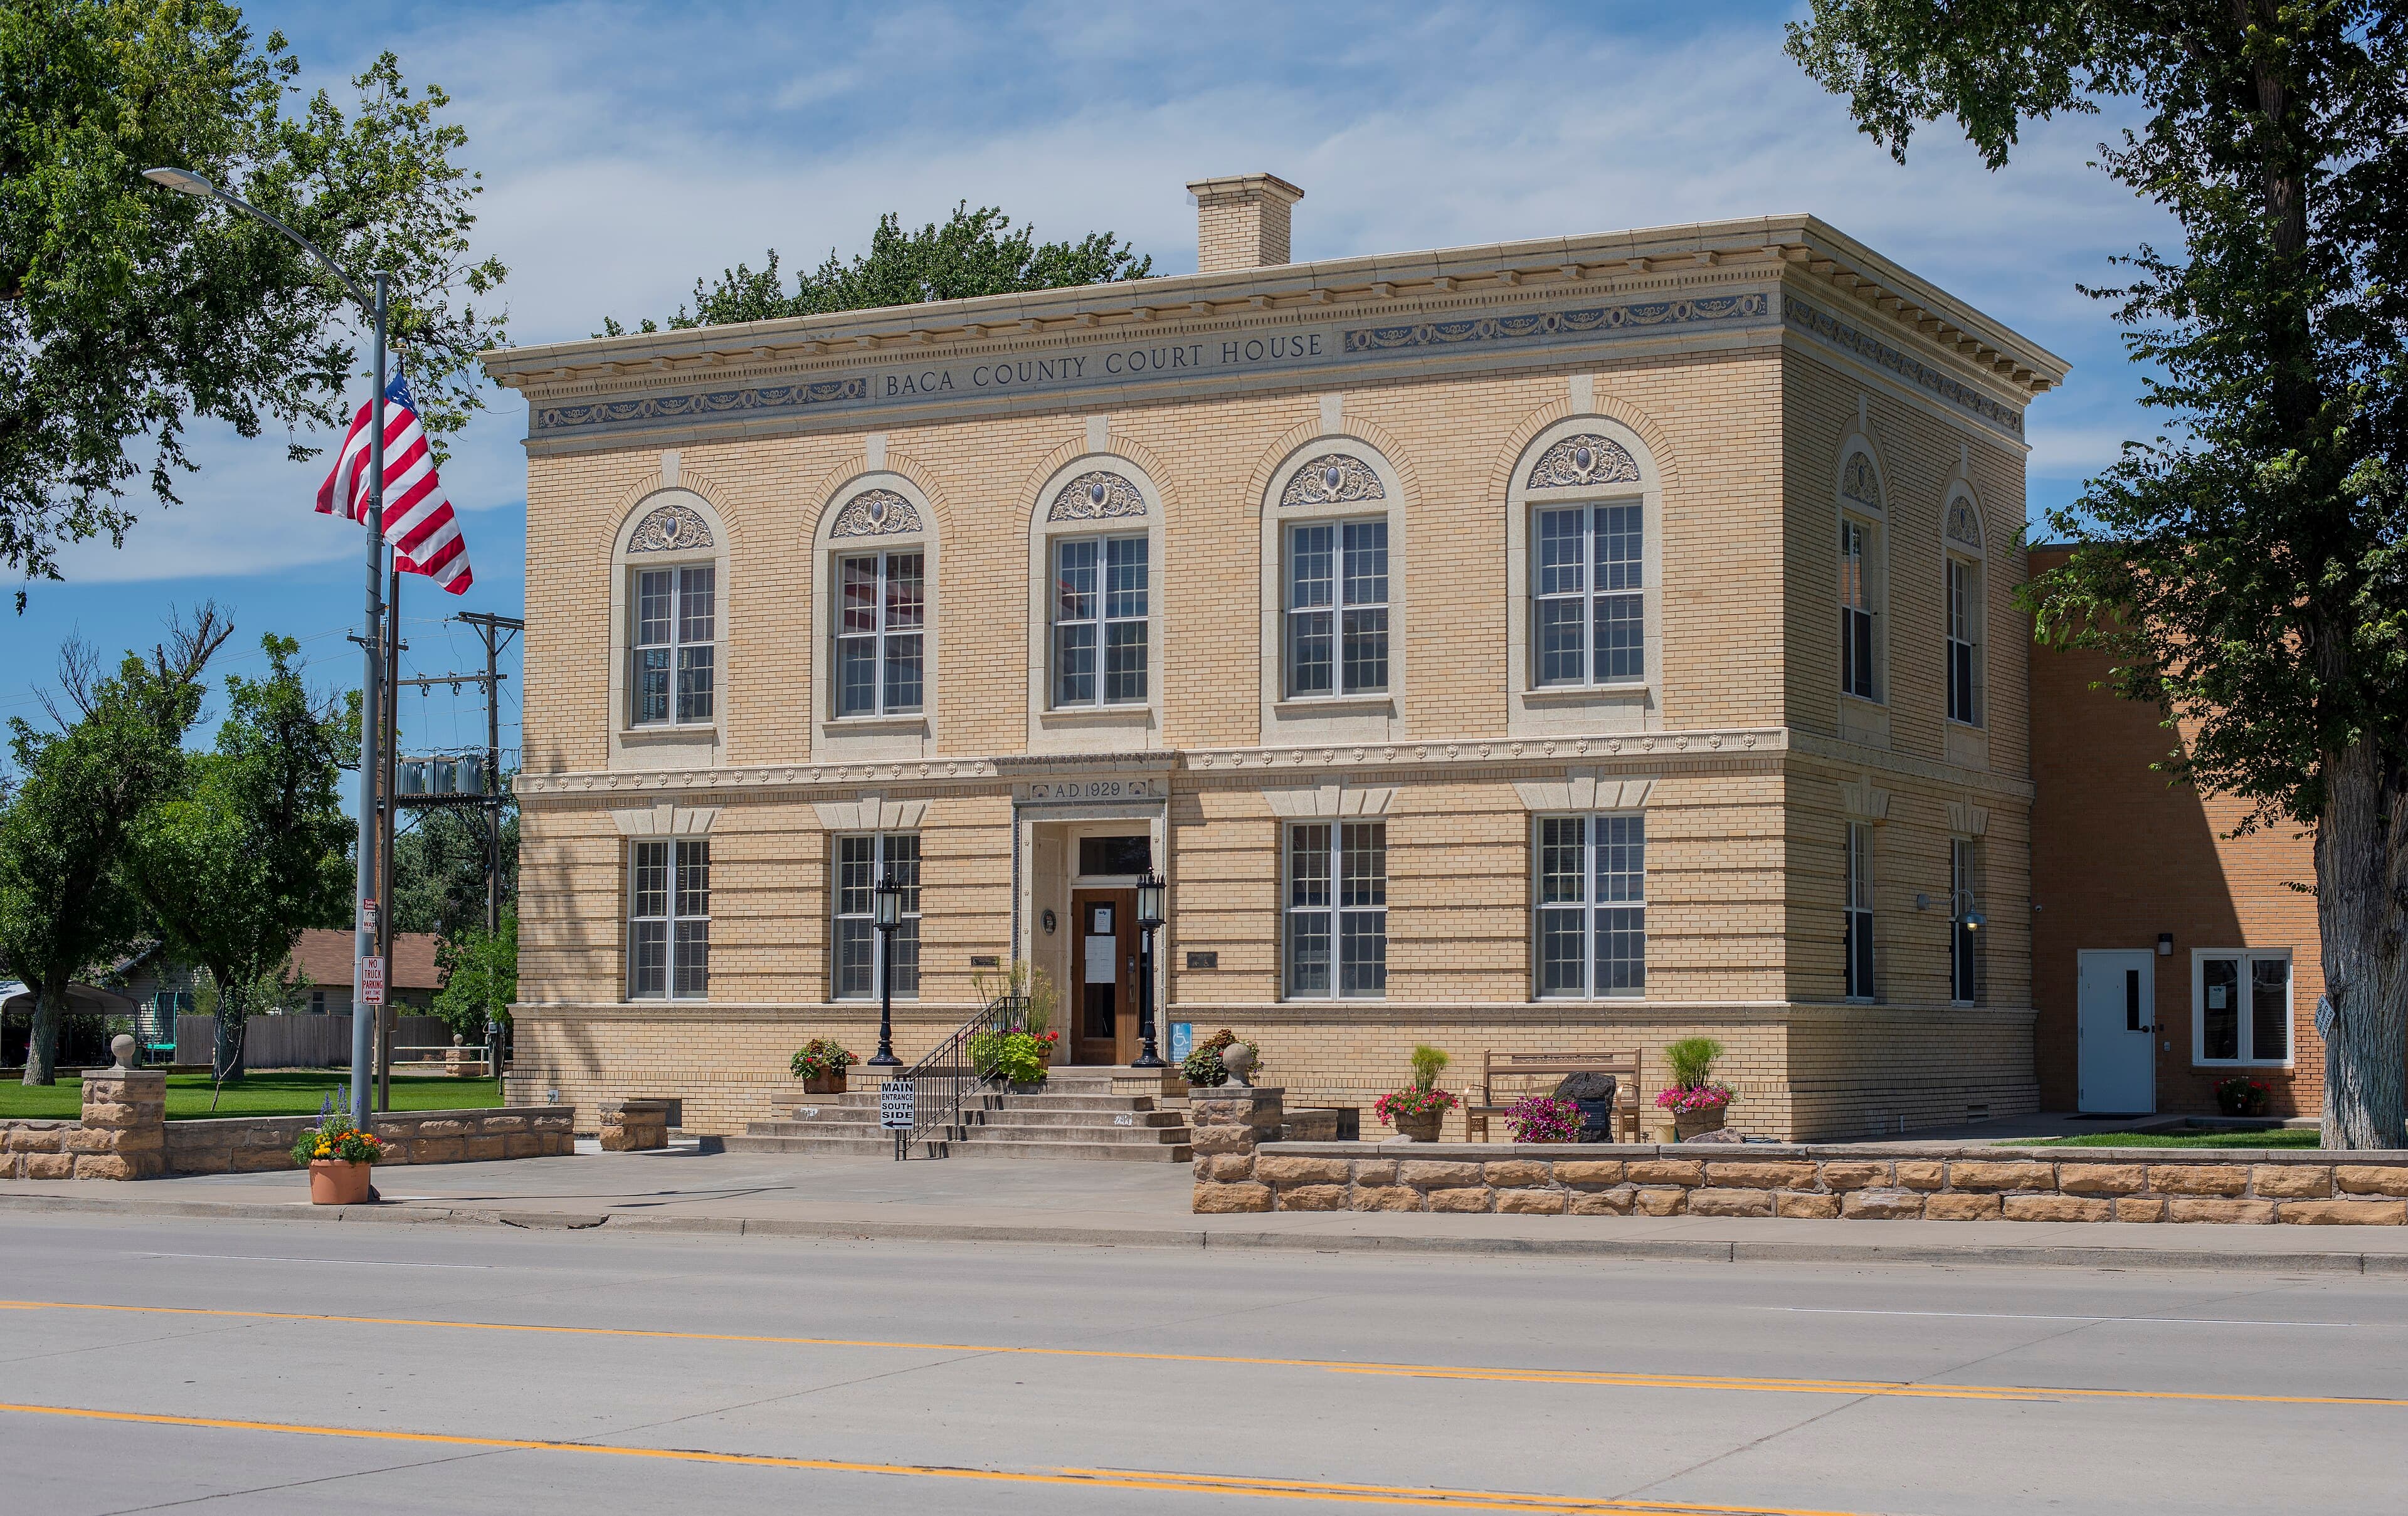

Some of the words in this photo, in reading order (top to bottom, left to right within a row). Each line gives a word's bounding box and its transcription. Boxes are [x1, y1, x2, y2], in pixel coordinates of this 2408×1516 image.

[886, 370, 955, 396] BACA
[973, 356, 1087, 386] COUNTY
[1106, 344, 1203, 374] COURT
[1221, 334, 1323, 364] HOUSE
[1055, 784, 1081, 797] A.D.
[1085, 782, 1120, 796] 1929
[369, 959, 378, 969] NO
[364, 969, 381, 979] TRUCK
[363, 980, 383, 989] PARKING
[2318, 1006, 2328, 1031] ALLOWED
[2321, 1029, 2326, 1039] ON
[2324, 1010, 2333, 1030] GRASS
[882, 1083, 912, 1092] MAIN
